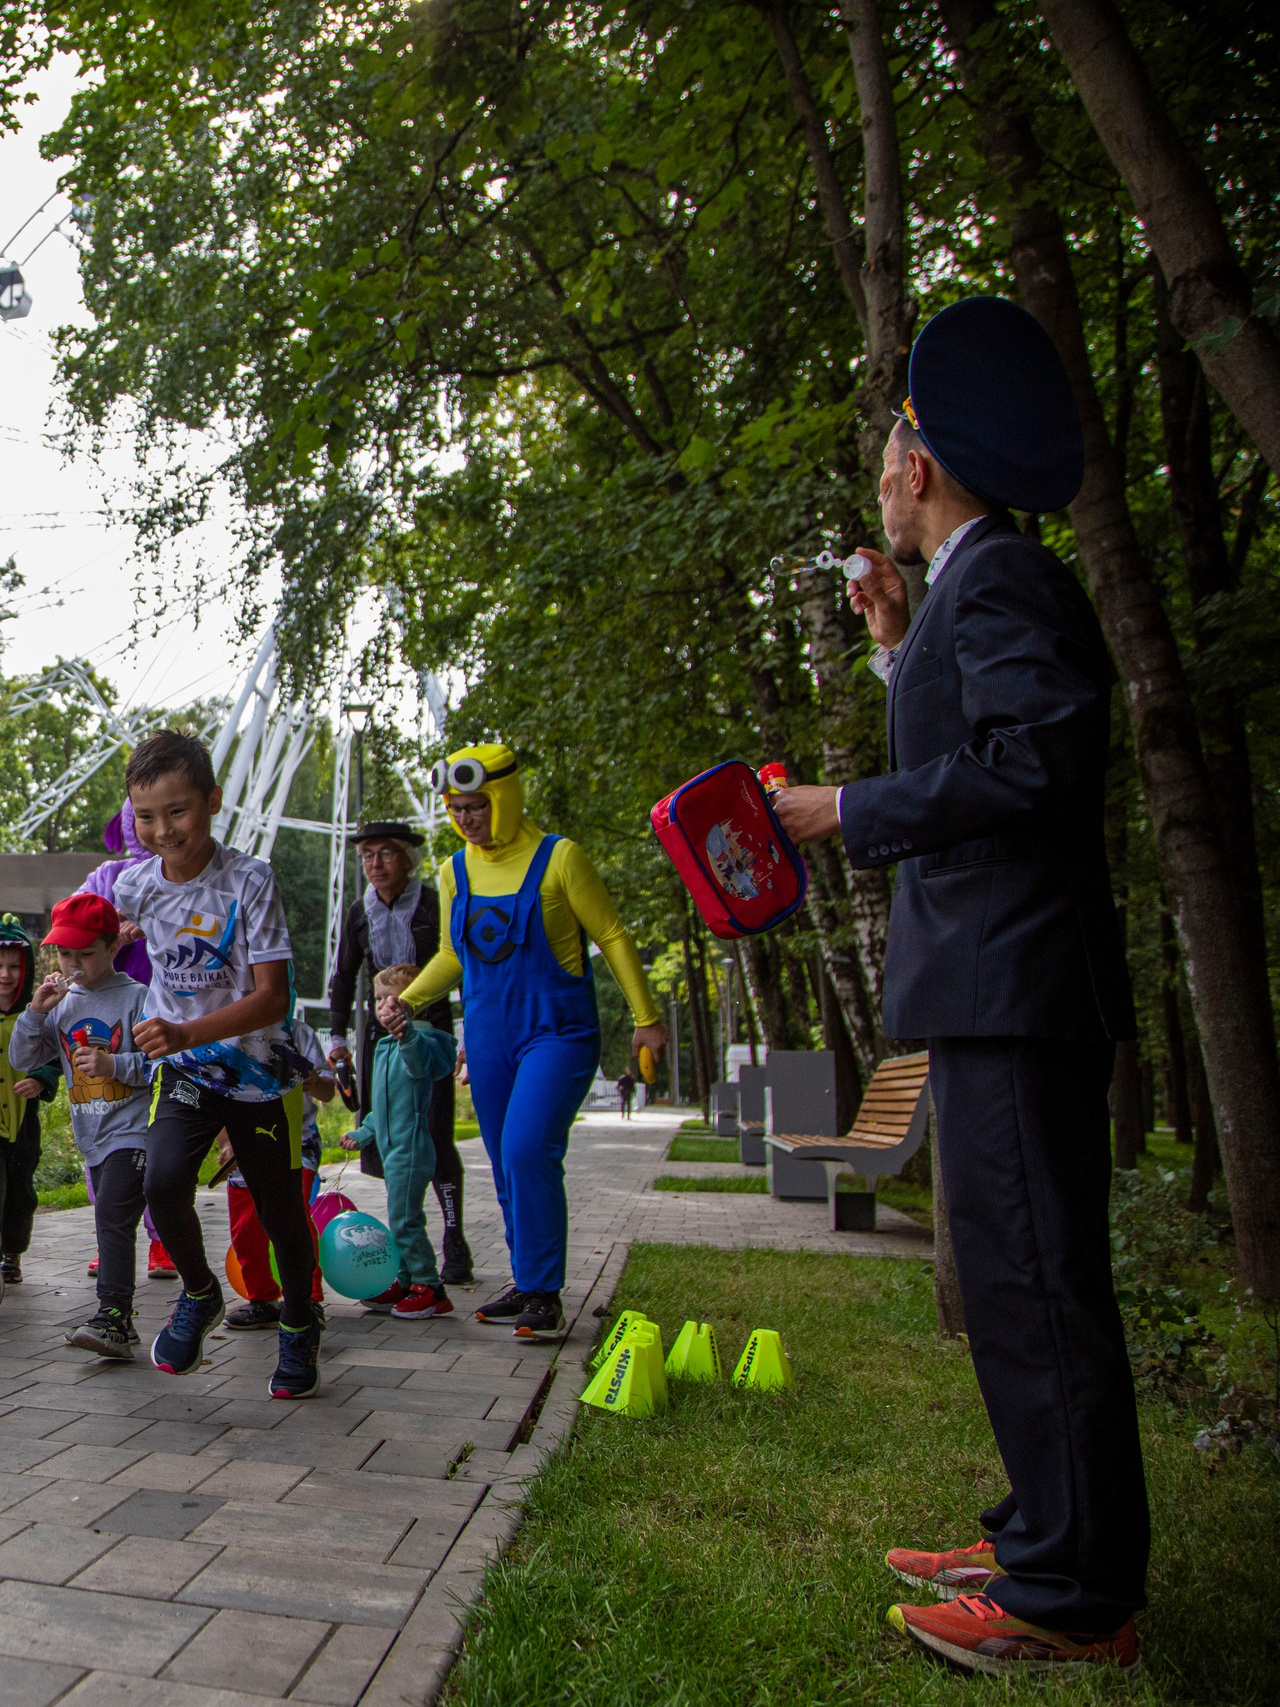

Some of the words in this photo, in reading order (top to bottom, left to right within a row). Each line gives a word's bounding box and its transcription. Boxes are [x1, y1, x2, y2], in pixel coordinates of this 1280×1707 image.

[164, 969, 187, 983] PURE
[190, 970, 229, 983] BAIKAL
[163, 980, 231, 990] MARATHON
